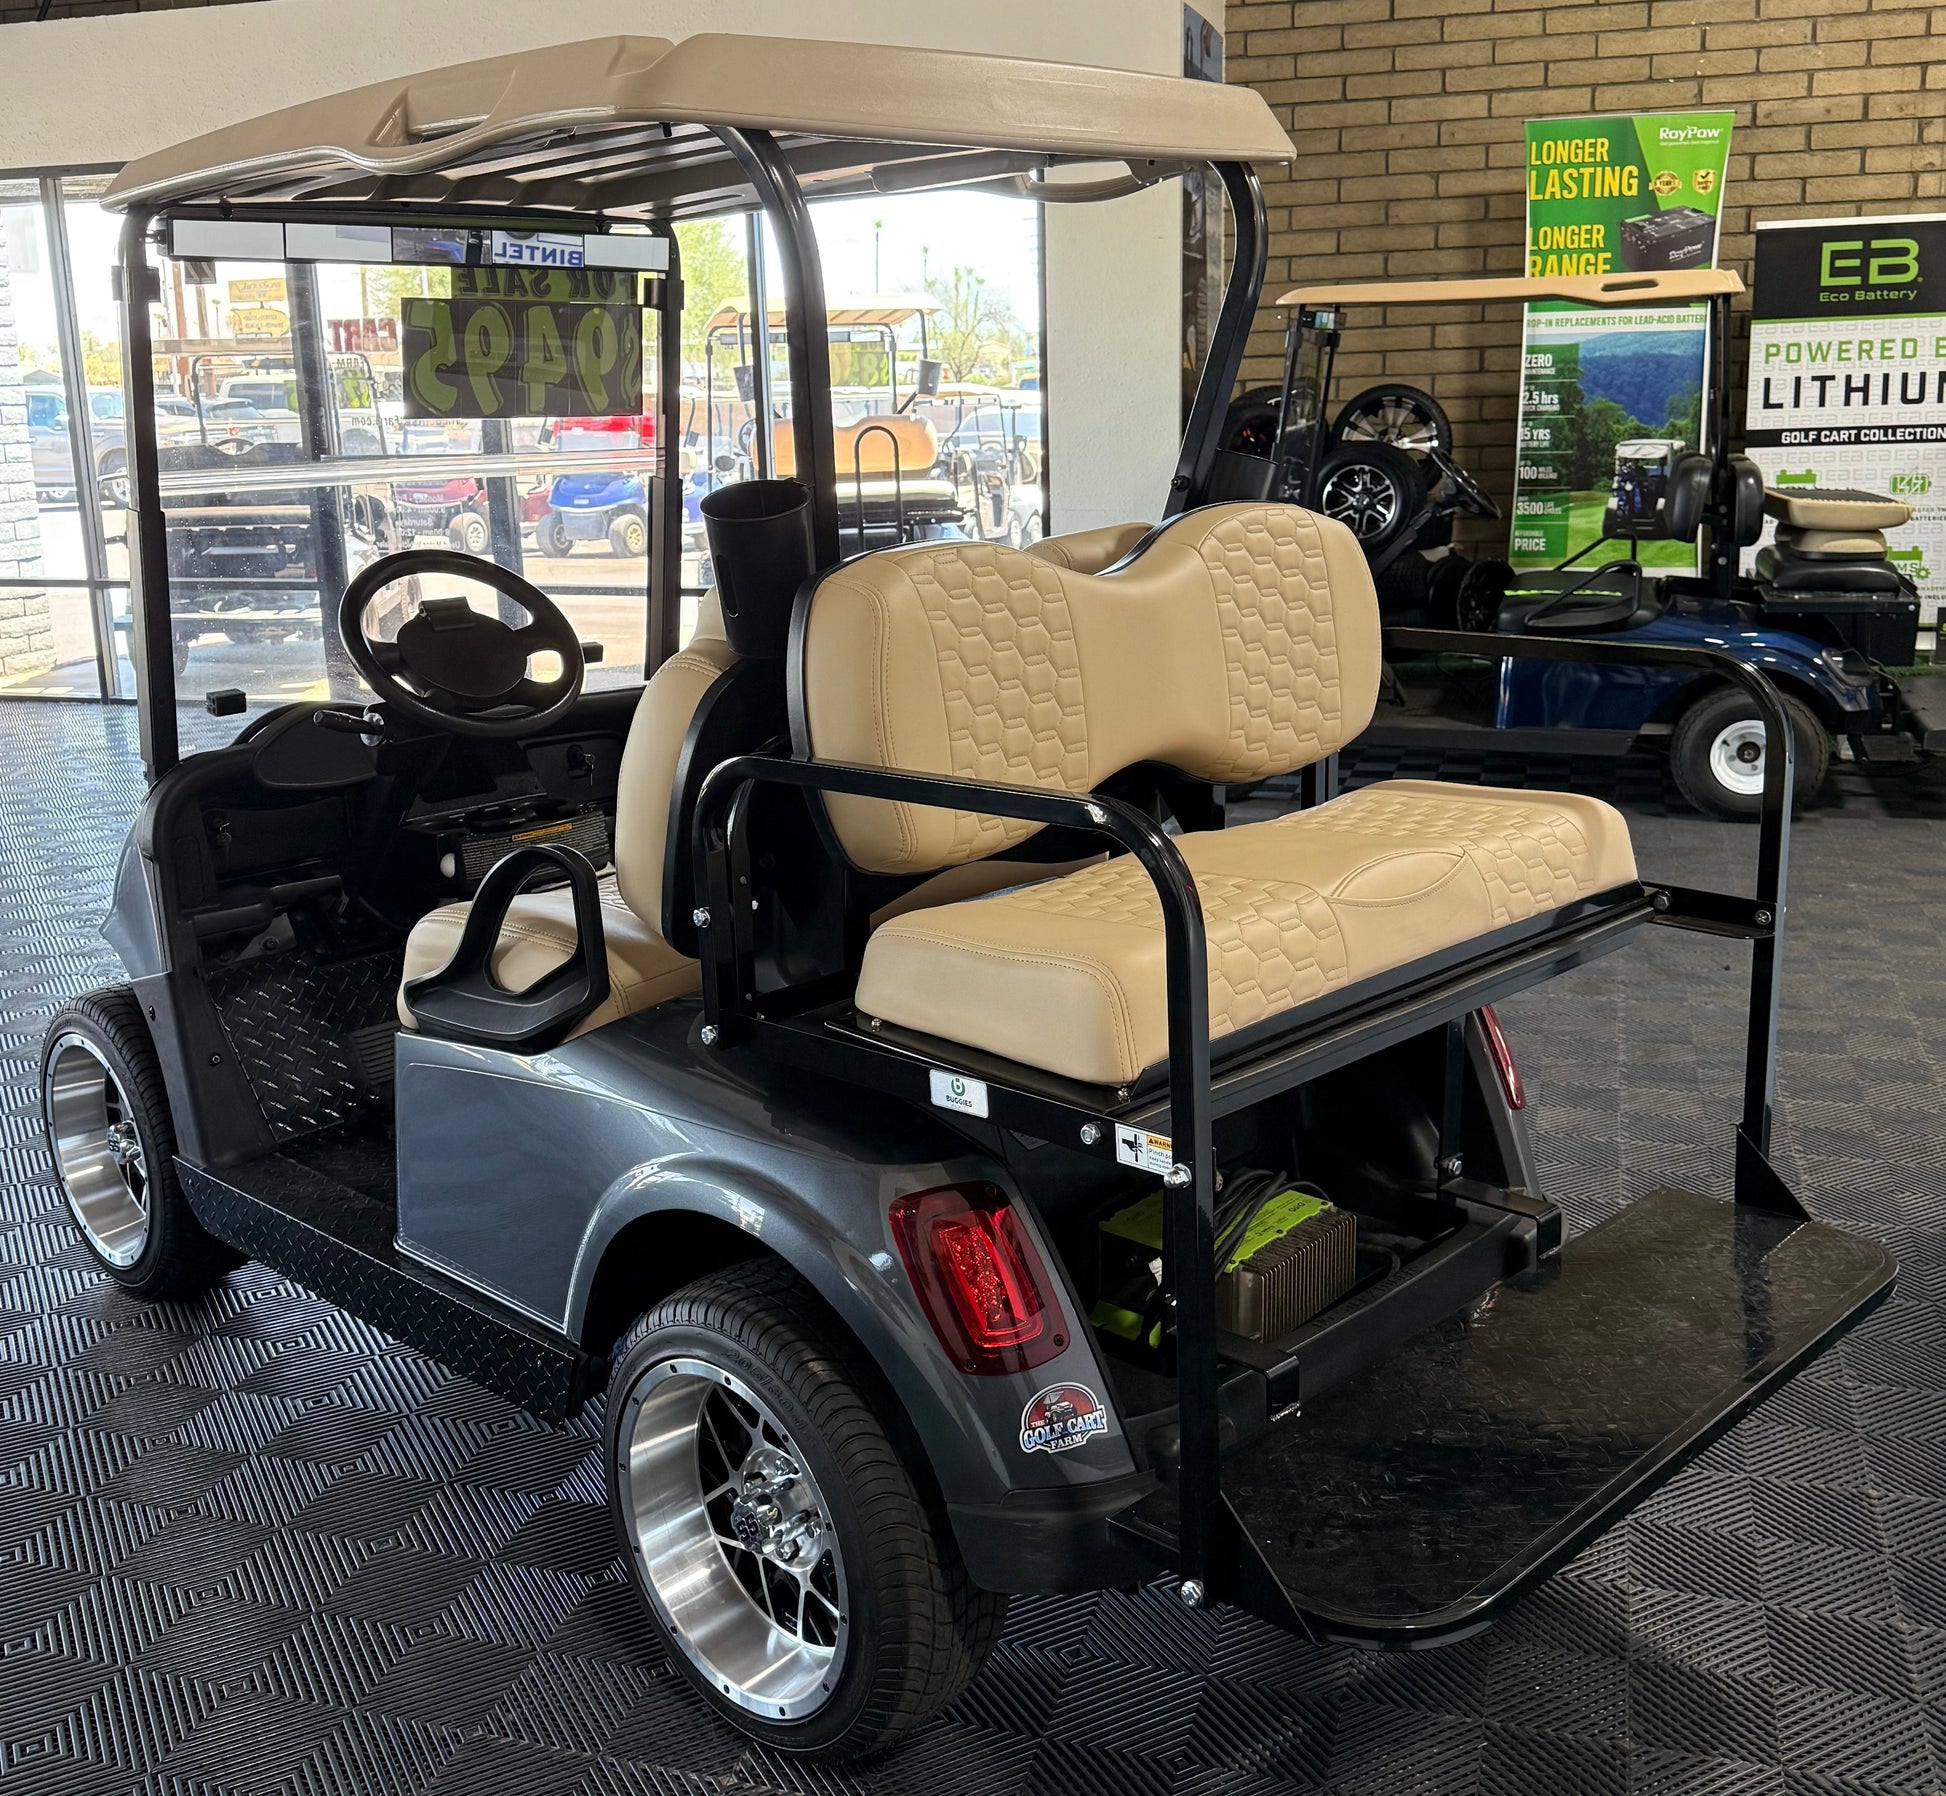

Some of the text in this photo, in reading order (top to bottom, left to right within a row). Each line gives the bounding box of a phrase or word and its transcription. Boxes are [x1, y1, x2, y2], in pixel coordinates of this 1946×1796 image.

[1530, 138, 1609, 166] LONGER
[1529, 165, 1639, 201] LASTING
[1529, 225, 1605, 251] LONGER
[1820, 238, 1920, 287] EB
[1819, 289, 1918, 301] Eco Battery
[1527, 318, 1553, 328] ROP-IN
[1555, 316, 1616, 328] REPLACEMENTS
[1618, 315, 1633, 326] FOR
[1635, 314, 1675, 325] LEAD-ACID
[1764, 337, 1918, 364] POWERED
[1525, 353, 1552, 368] ZERO
[1522, 391, 1559, 405] 2.5 hrs
[1532, 428, 1551, 440] YRS
[1781, 426, 1946, 444] GOLF CART COLLECTION
[1519, 466, 1538, 480] 100
[1516, 501, 1544, 515] 3500
[1514, 538, 1547, 551] PRICE
[946, 1094, 973, 1108] BUGGIES
[1154, 1138, 1172, 1149] WARN
[1023, 1410, 1104, 1449] GOLF CART
[1031, 1419, 1046, 1428] THE
[1050, 1433, 1083, 1450] FARM
